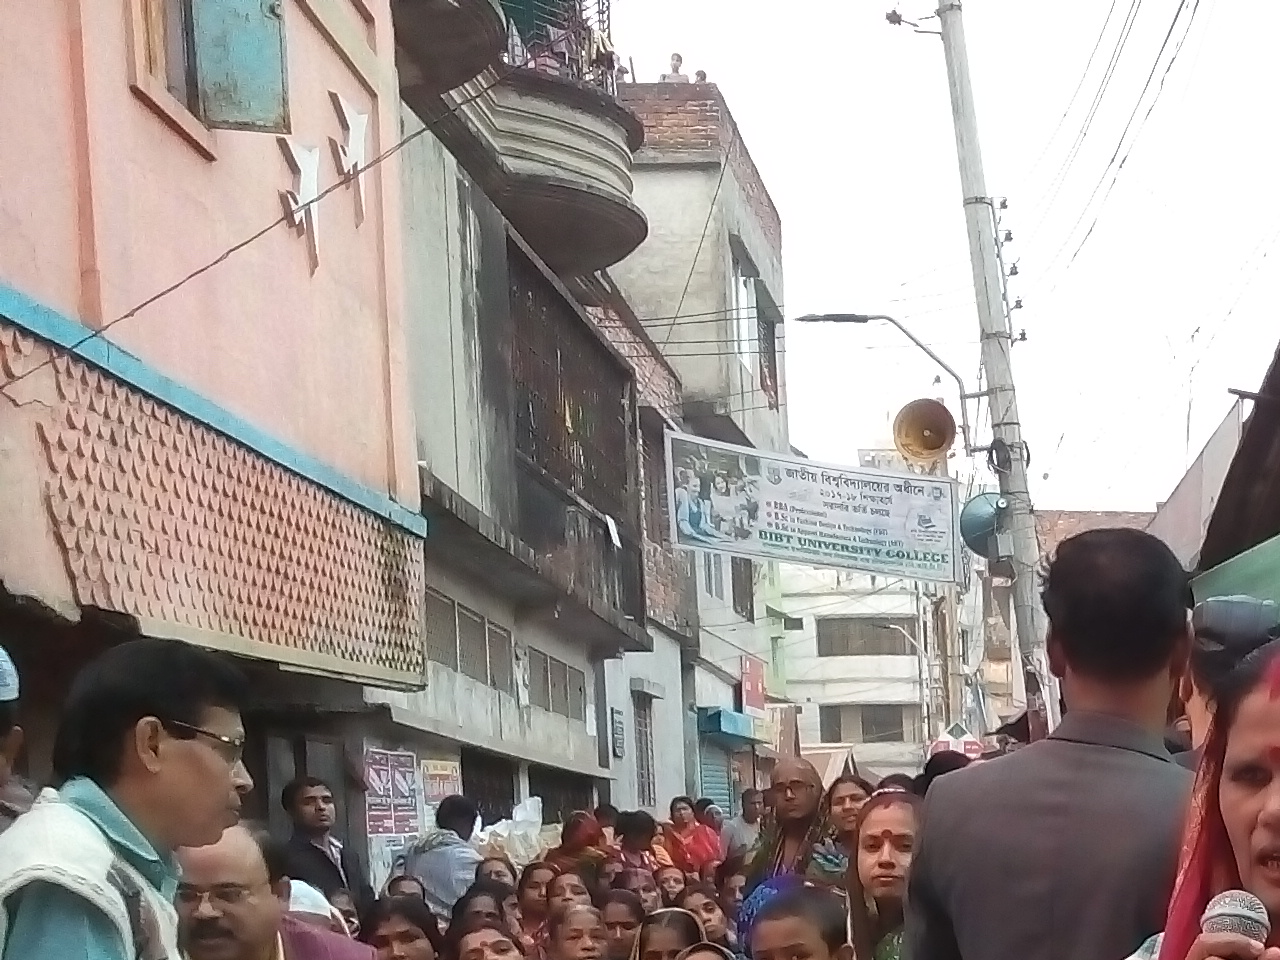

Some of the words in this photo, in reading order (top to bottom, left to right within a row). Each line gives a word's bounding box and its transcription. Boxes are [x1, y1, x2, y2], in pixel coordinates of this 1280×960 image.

[784, 466, 817, 483] জাতীয়
[893, 481, 924, 496] অধীনে
[797, 536, 883, 558] UNIVERSITY
[886, 549, 949, 564] COLLEGE
